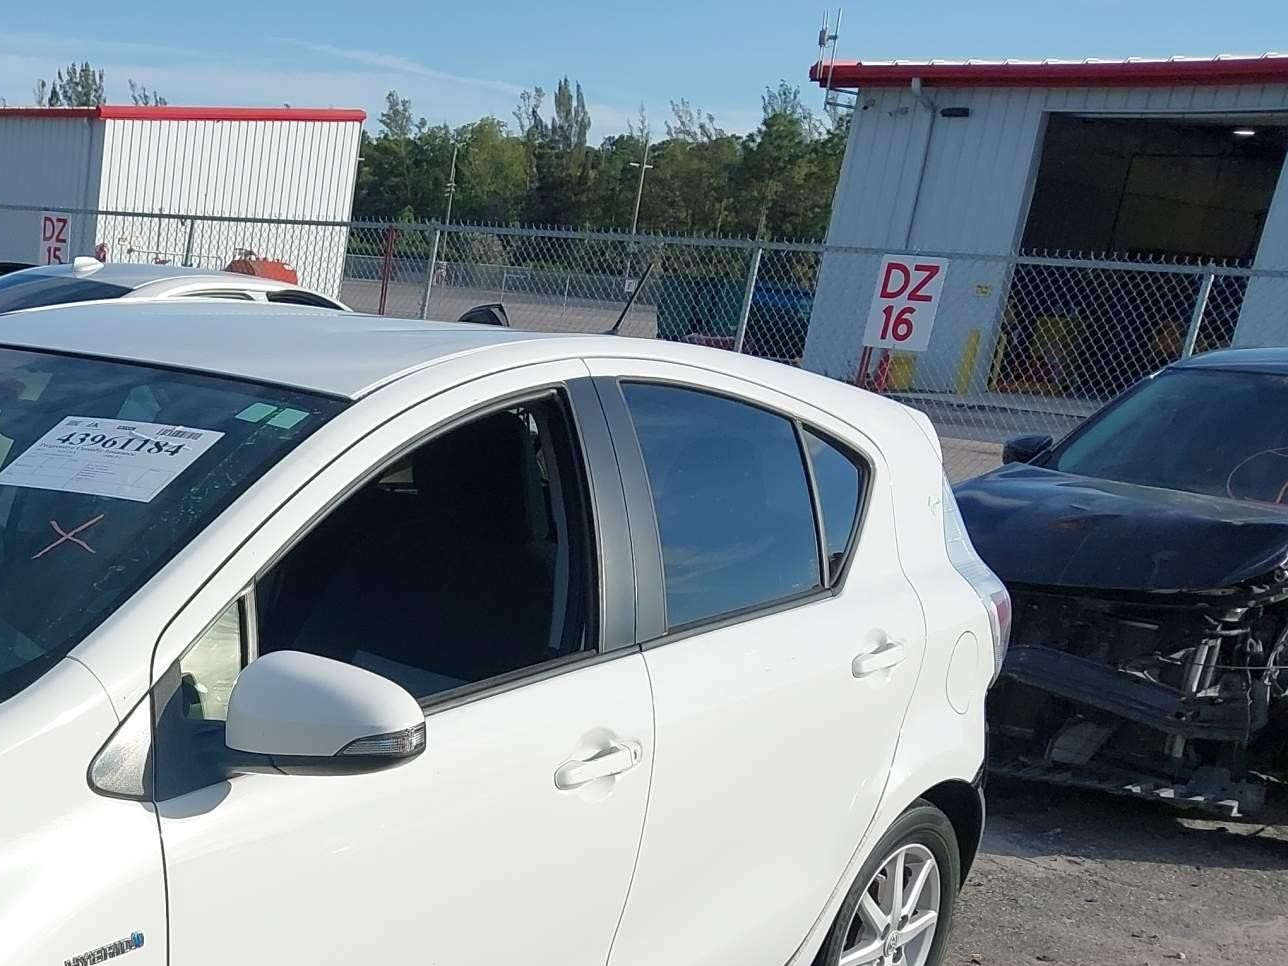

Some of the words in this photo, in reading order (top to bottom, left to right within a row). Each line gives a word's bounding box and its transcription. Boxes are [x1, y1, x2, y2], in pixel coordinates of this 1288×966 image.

[43, 216, 67, 243] DZ
[47, 246, 62, 264] 15
[880, 262, 940, 302] DZ
[880, 305, 916, 341] 16
[56, 431, 185, 457] 43961184
